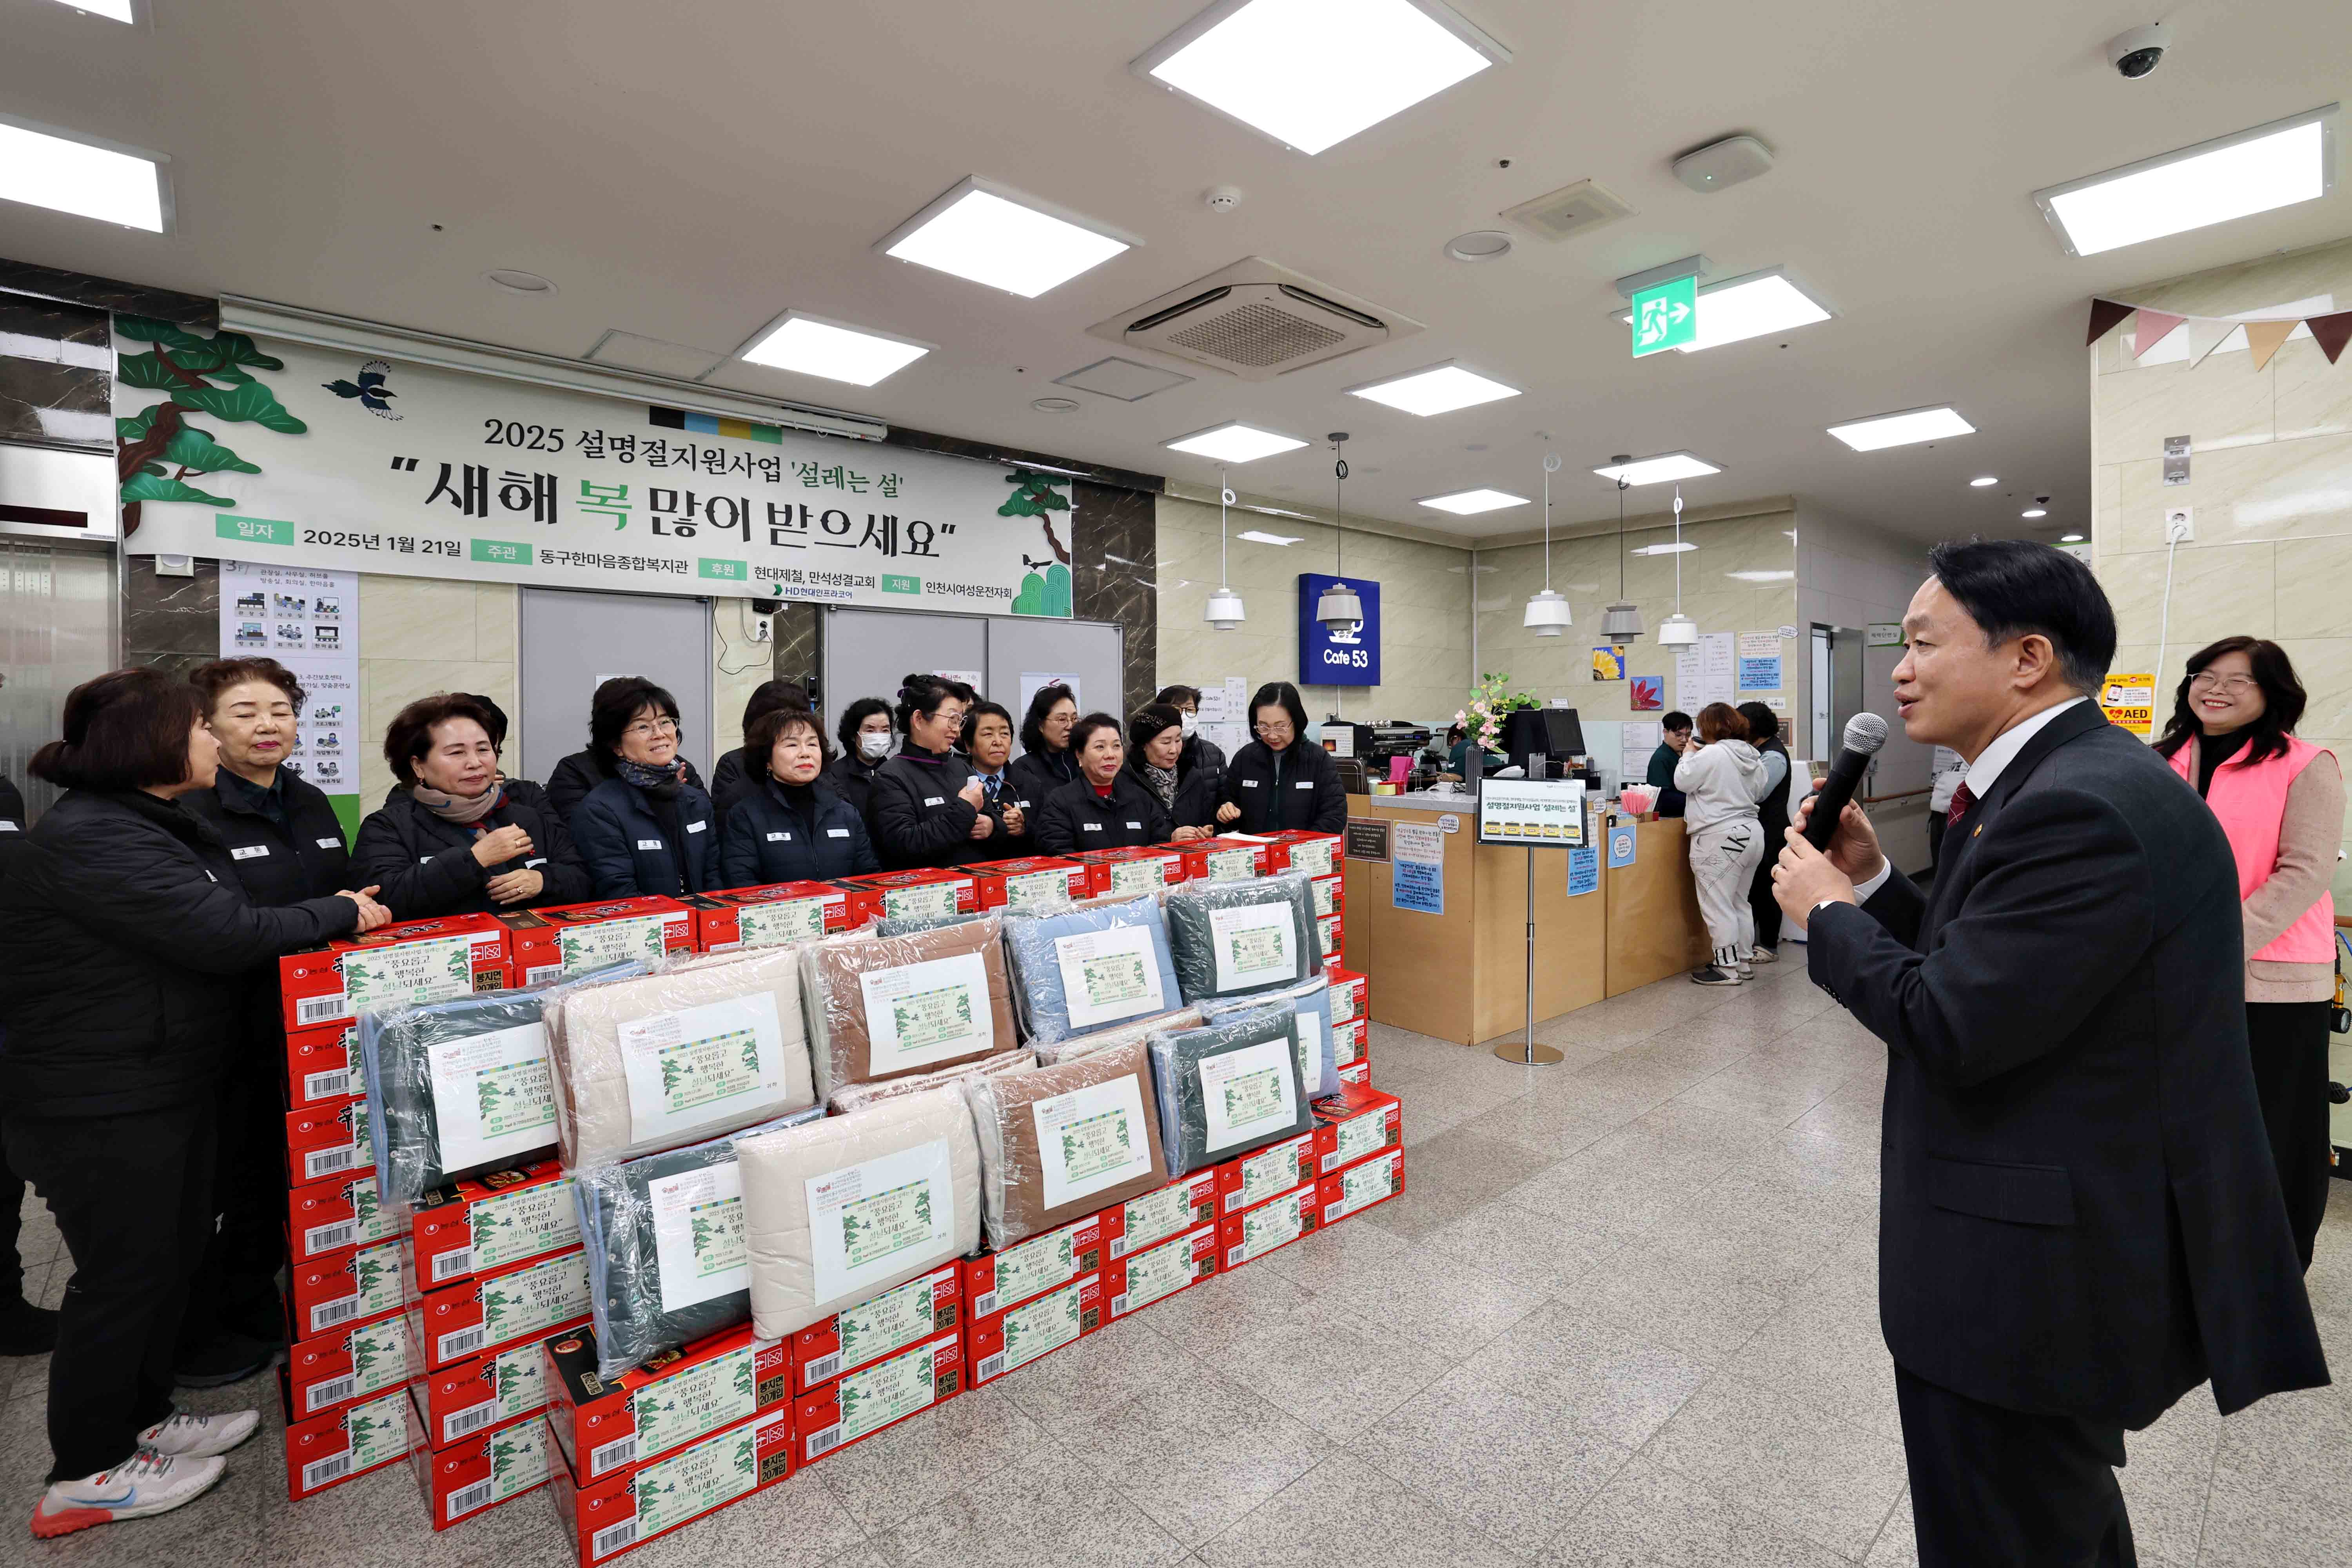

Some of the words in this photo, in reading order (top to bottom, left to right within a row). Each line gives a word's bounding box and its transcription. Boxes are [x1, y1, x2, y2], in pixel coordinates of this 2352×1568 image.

[485, 419, 564, 453] 2025
[575, 429, 782, 483] 설명절지원사업
[791, 460, 869, 494] '설레는
[877, 472, 904, 498] 설'
[391, 455, 557, 525] "새해
[575, 479, 632, 532] 복
[648, 487, 750, 543] 많이
[768, 503, 955, 559] 받으세요"
[237, 520, 274, 539] 일자
[304, 530, 380, 551] 2025년
[388, 536, 415, 554] 1월
[421, 540, 461, 557] 21일
[488, 545, 516, 560] 주관
[539, 550, 688, 573] 동구한마음종합복지관
[712, 562, 735, 575] 후원
[755, 566, 806, 584] 현대제철,
[809, 571, 875, 588] 만석성결교회
[892, 579, 910, 591] 지원
[926, 582, 1012, 598] 인천시여성운전자회
[785, 587, 852, 600] HD현대인프라코어
[1324, 649, 1350, 665] Cafe
[1352, 650, 1368, 668] 53
[2124, 710, 2147, 718] AED
[1486, 802, 1540, 811] 설명절지원사업
[476, 970, 501, 983] 봉지면
[521, 1208, 551, 1225] 행복한
[936, 1305, 955, 1319] 봉지면
[936, 1315, 955, 1331] 20개입
[760, 1375, 784, 1392] 봉지면
[937, 1371, 957, 1386] 봉지면
[759, 1389, 784, 1405] 20개입
[937, 1381, 957, 1397] 20개입
[762, 1451, 786, 1469] 봉지면
[762, 1465, 786, 1482] 20개입
